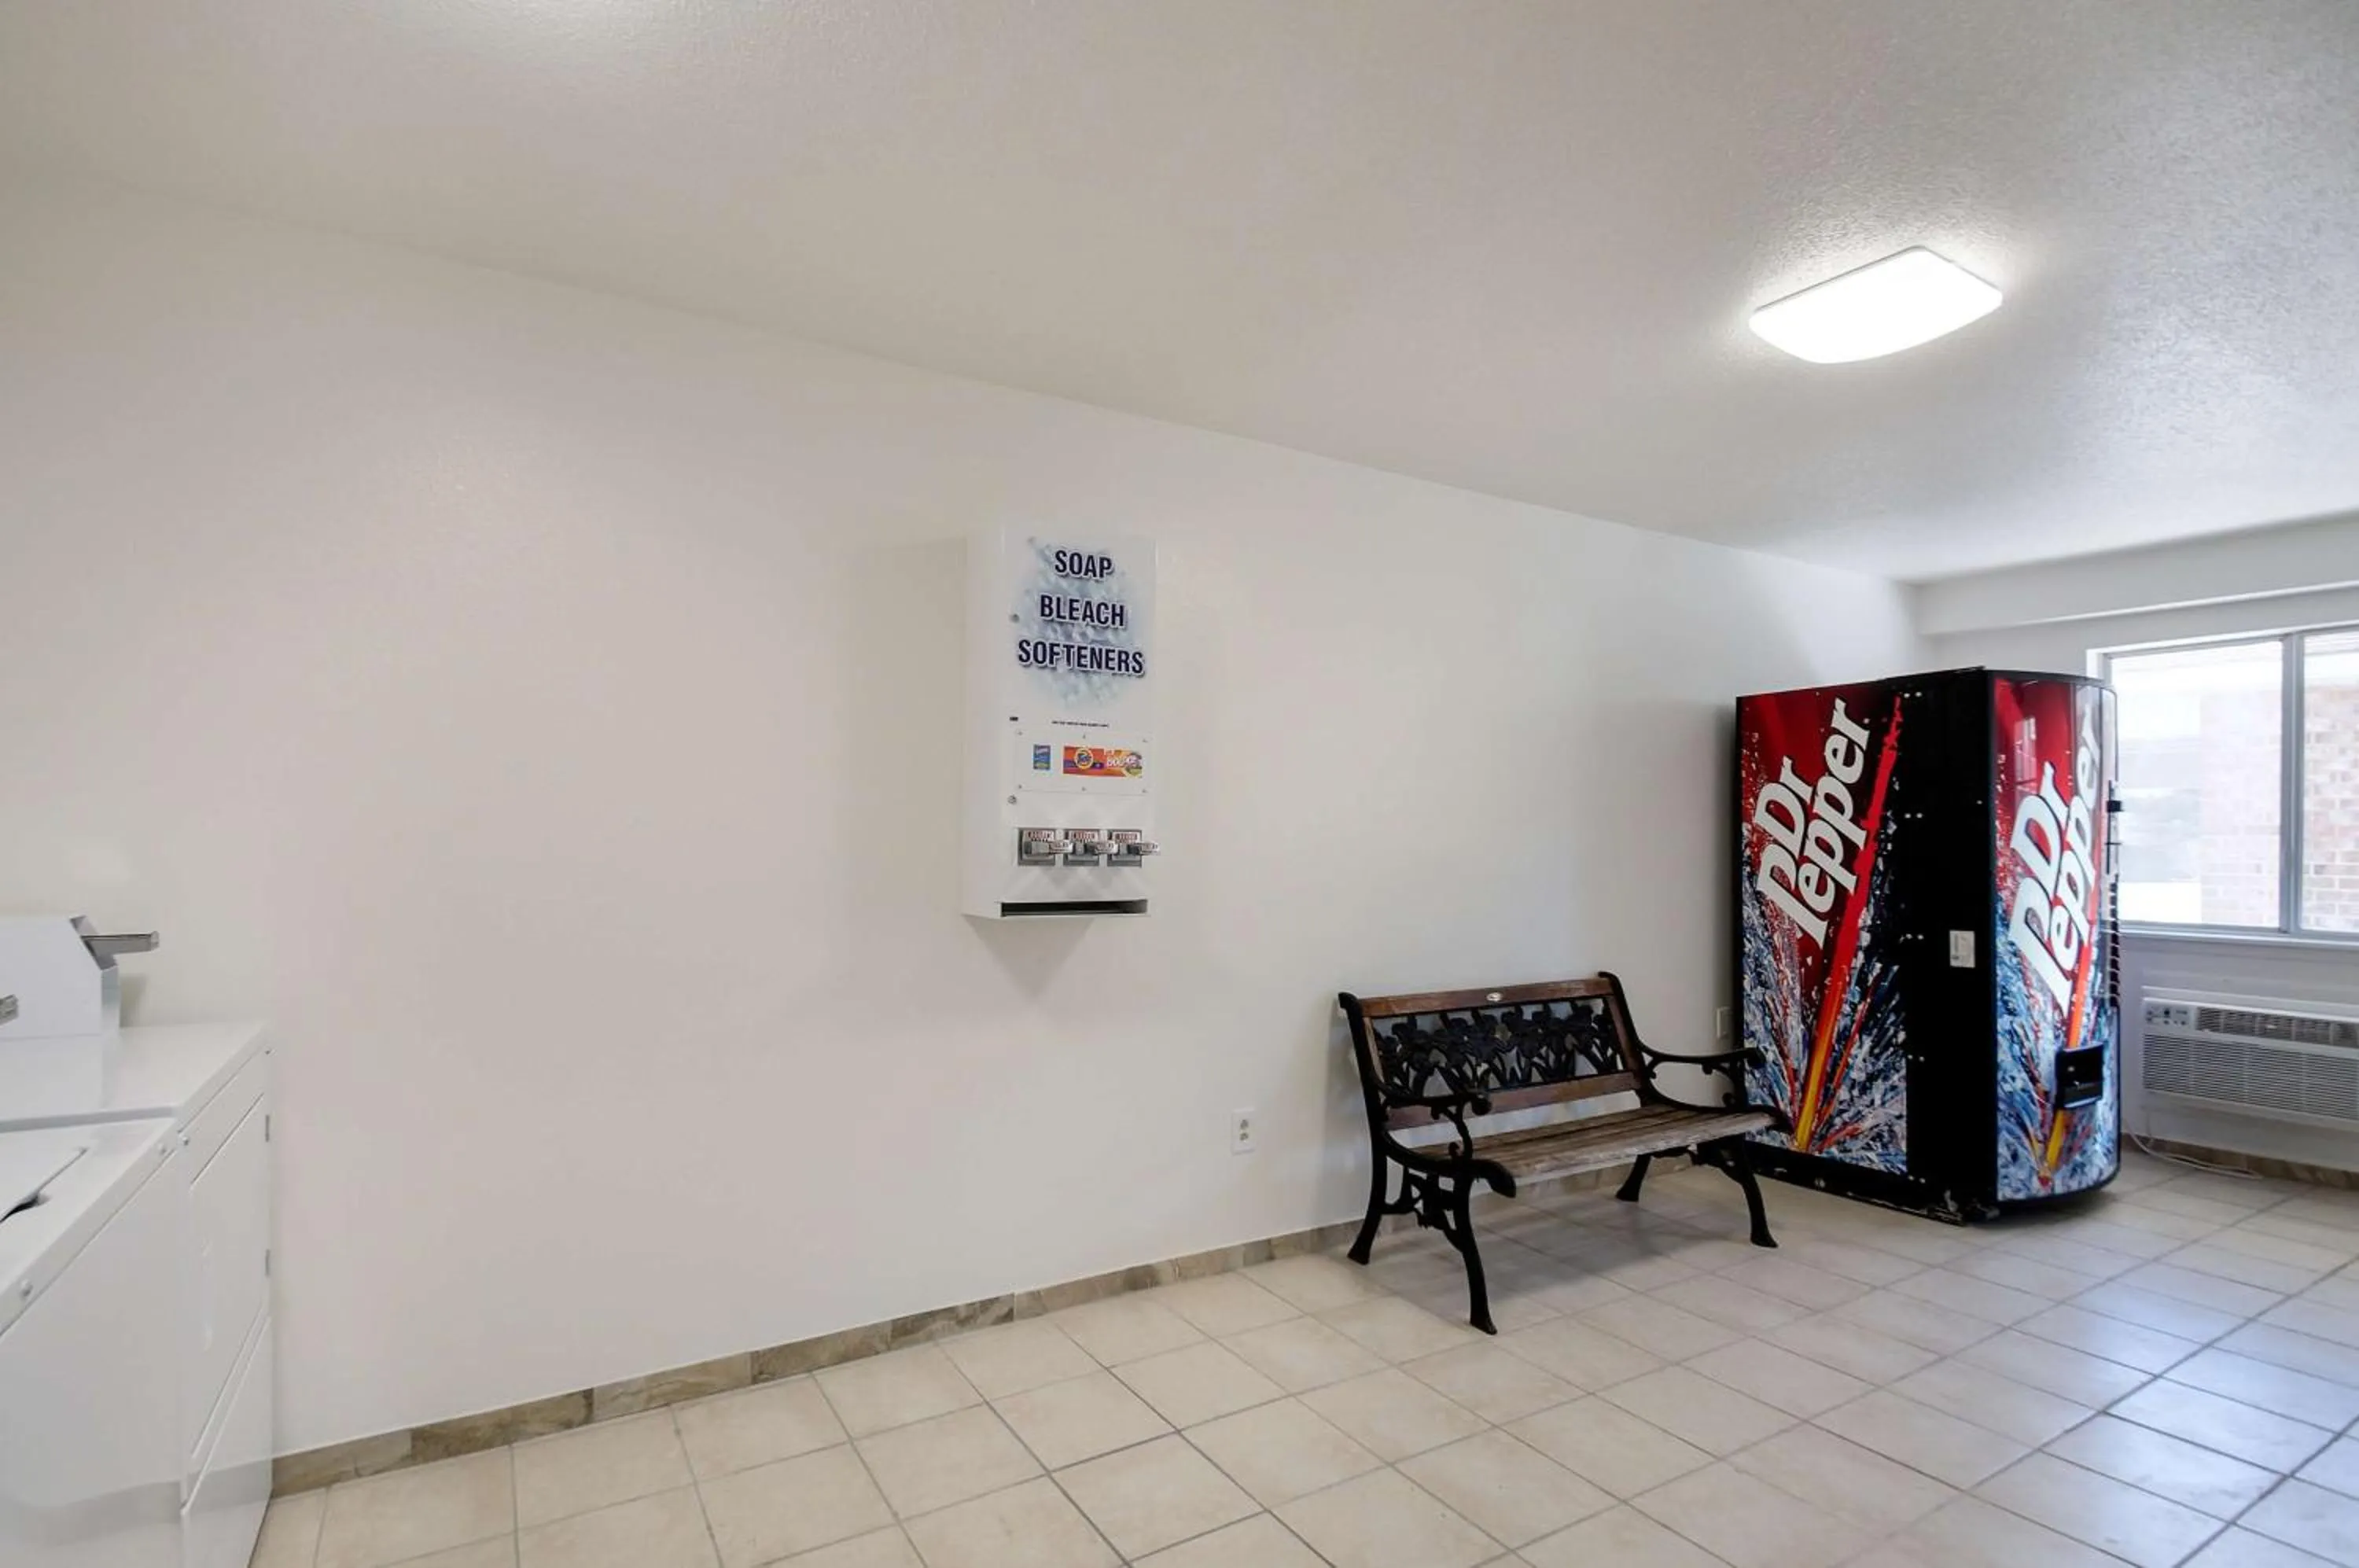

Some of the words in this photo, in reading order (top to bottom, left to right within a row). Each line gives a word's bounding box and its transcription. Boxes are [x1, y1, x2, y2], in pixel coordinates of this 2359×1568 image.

[1040, 594, 1125, 628] BLEACH
[1054, 550, 1113, 579] SOAP
[1018, 639, 1145, 675] SOFTENERS
[1754, 755, 1813, 860] Dr
[1756, 697, 1871, 950] Pepper
[2010, 760, 2070, 895] Dr
[2008, 705, 2100, 1021] Pepper
